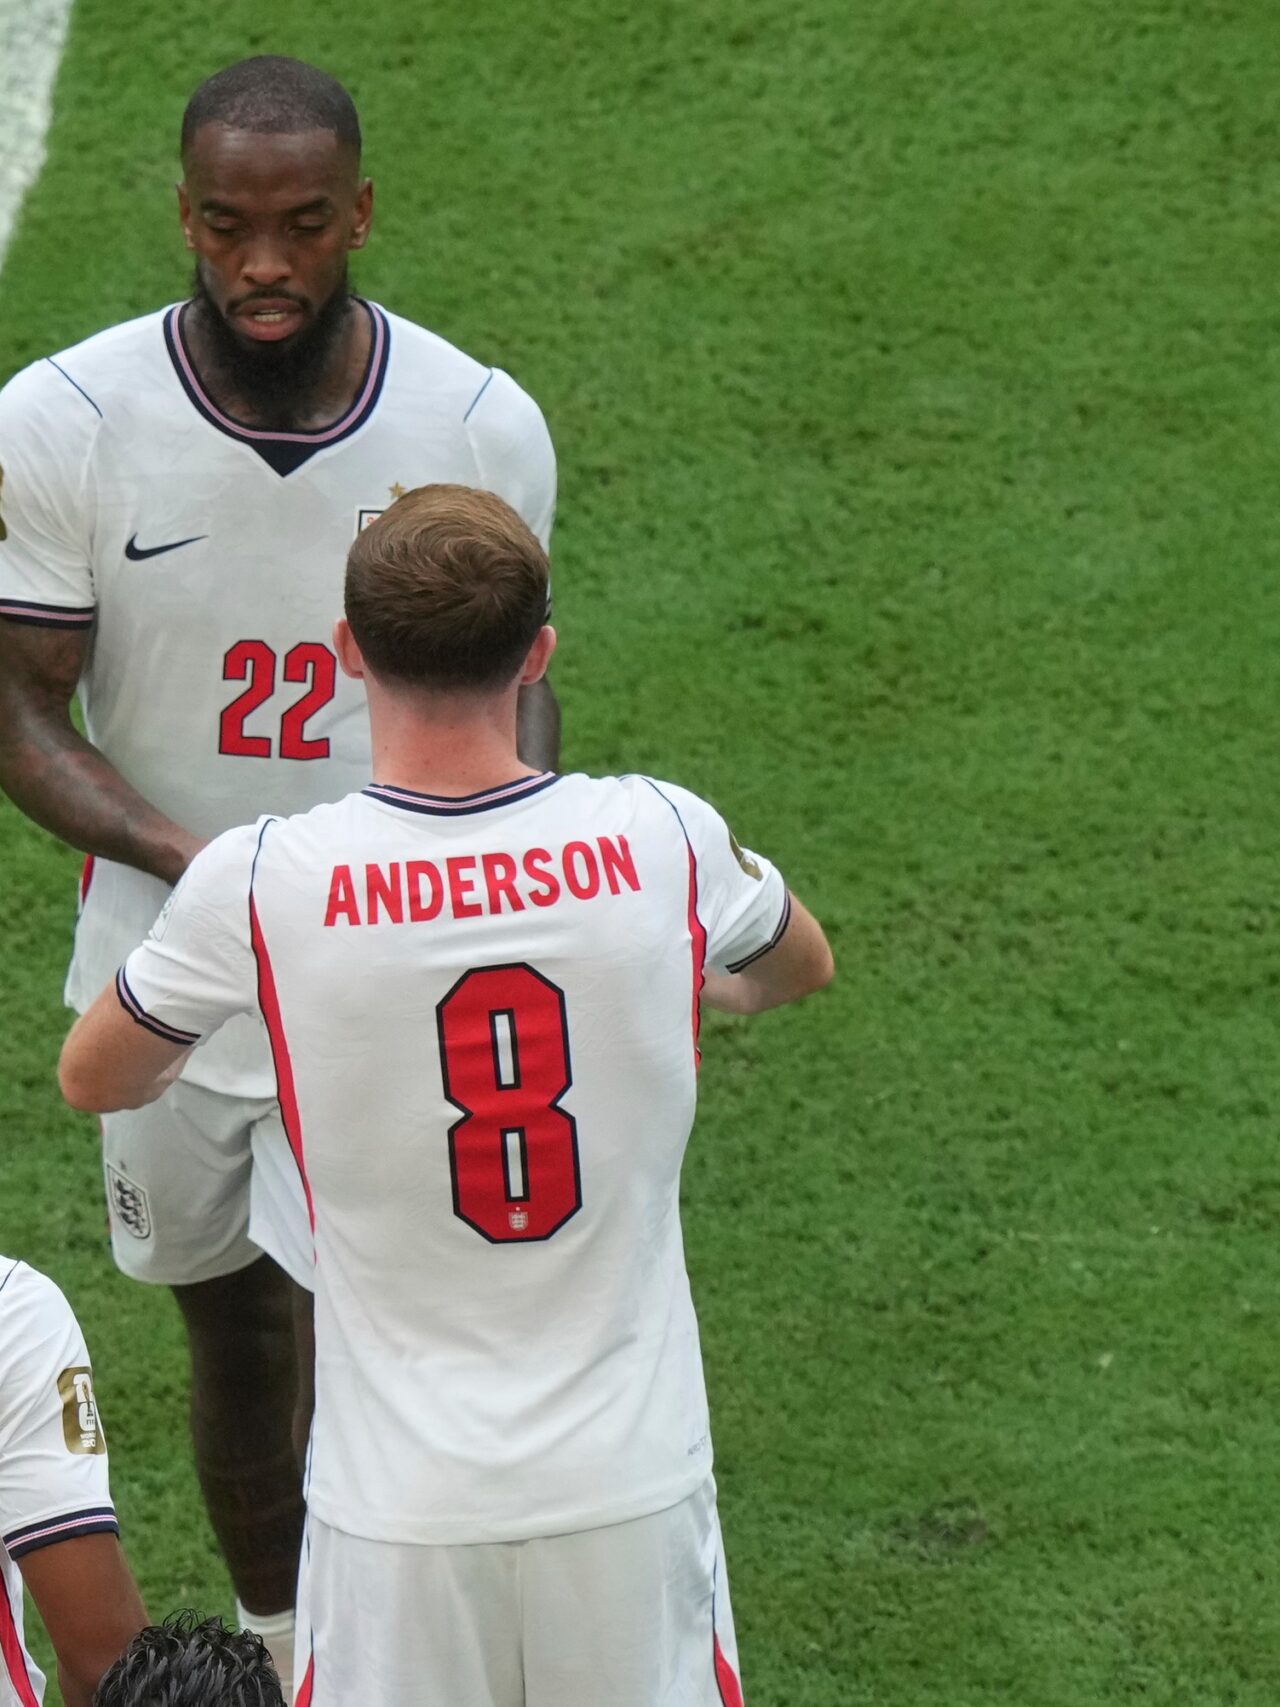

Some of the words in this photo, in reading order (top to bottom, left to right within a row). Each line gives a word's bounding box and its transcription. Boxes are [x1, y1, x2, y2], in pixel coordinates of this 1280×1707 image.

[218, 639, 337, 760] 22
[323, 835, 642, 928] ANDERSON
[435, 962, 583, 1245] 8
